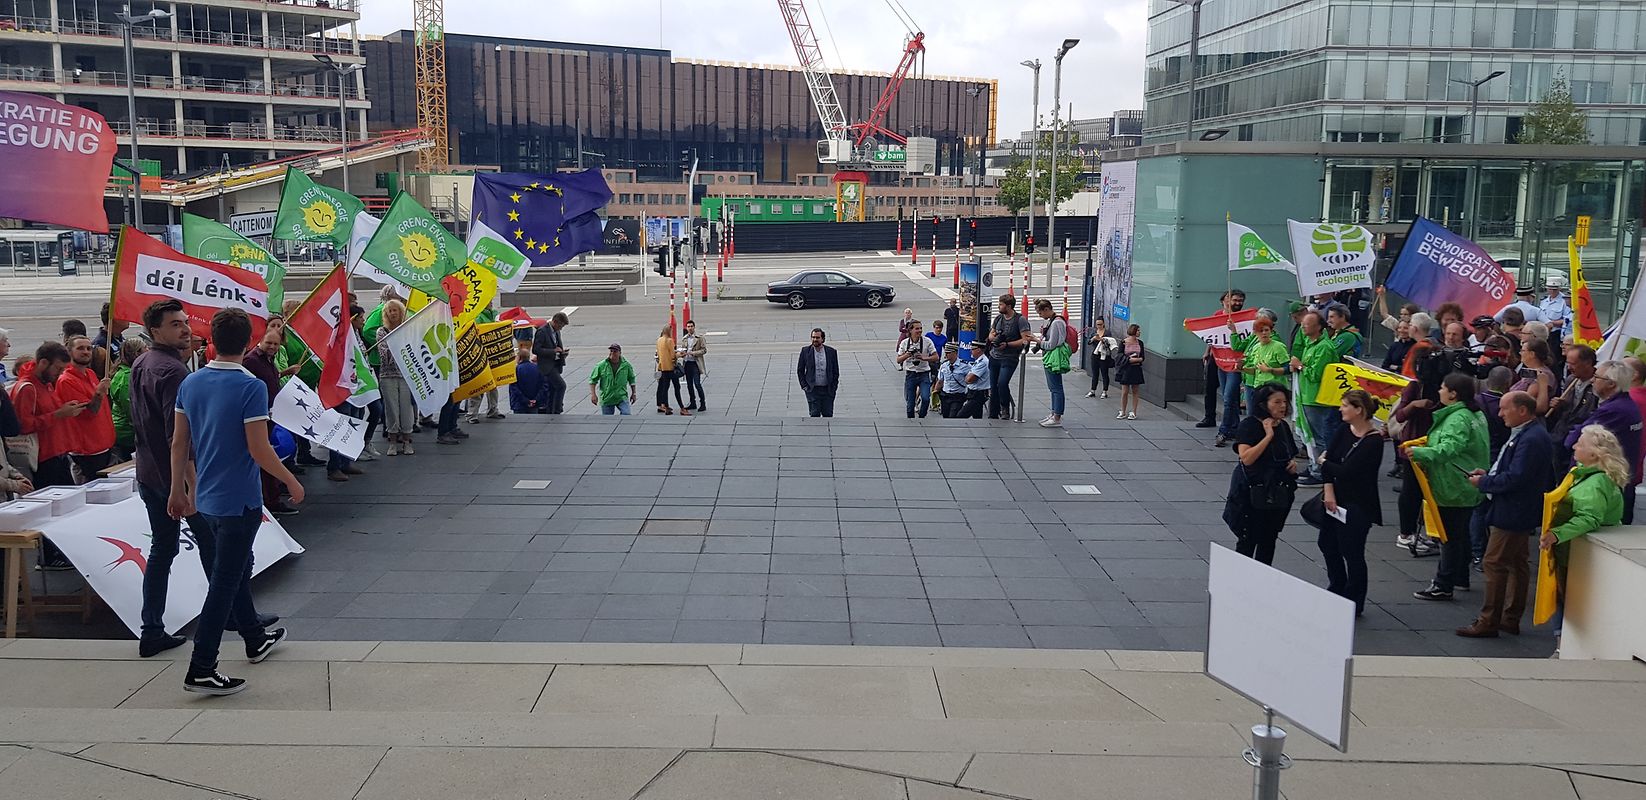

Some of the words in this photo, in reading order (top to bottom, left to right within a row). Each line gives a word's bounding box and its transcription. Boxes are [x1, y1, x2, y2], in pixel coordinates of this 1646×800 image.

[0, 102, 74, 127] RATIE
[79, 114, 103, 133] IN
[844, 184, 857, 199] 4
[232, 216, 273, 233] CATTENOM
[398, 217, 429, 233] GRENG
[388, 252, 410, 277] GRAD
[411, 271, 435, 282] ELO!
[473, 251, 514, 276] gréng
[1417, 241, 1504, 300] BEWEGUNG
[1424, 232, 1500, 279] DEMOKRATIE
[1498, 276, 1510, 290] IN
[146, 269, 185, 291] déi
[191, 276, 248, 304] Lénk
[1201, 335, 1218, 345] éi
[400, 348, 427, 401] écologique
[405, 343, 435, 395] mouvement
